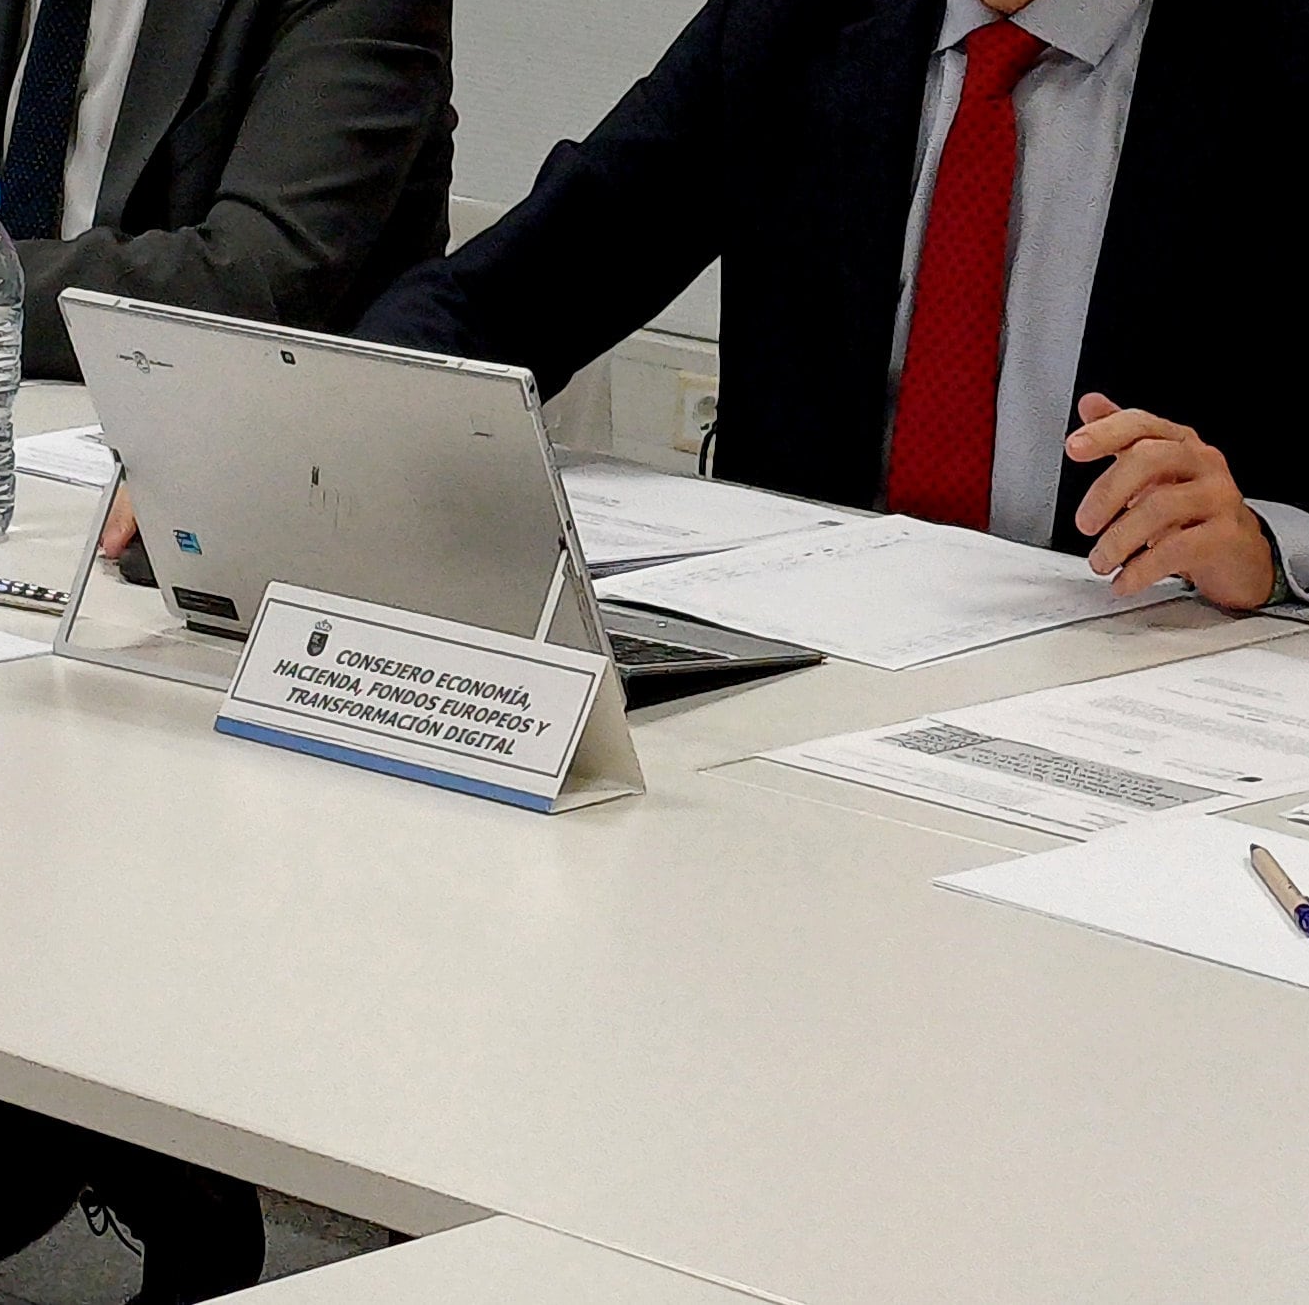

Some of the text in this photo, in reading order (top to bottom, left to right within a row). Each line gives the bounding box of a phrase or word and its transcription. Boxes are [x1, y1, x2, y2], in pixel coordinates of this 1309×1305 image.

[273, 659, 552, 738] HACIENDA, FONDOS EUROPEOS Y
[335, 649, 533, 711] CONSEJERO ECONOMÍA,
[285, 687, 516, 756] TRANSFORMACIÓN DIGITAL
